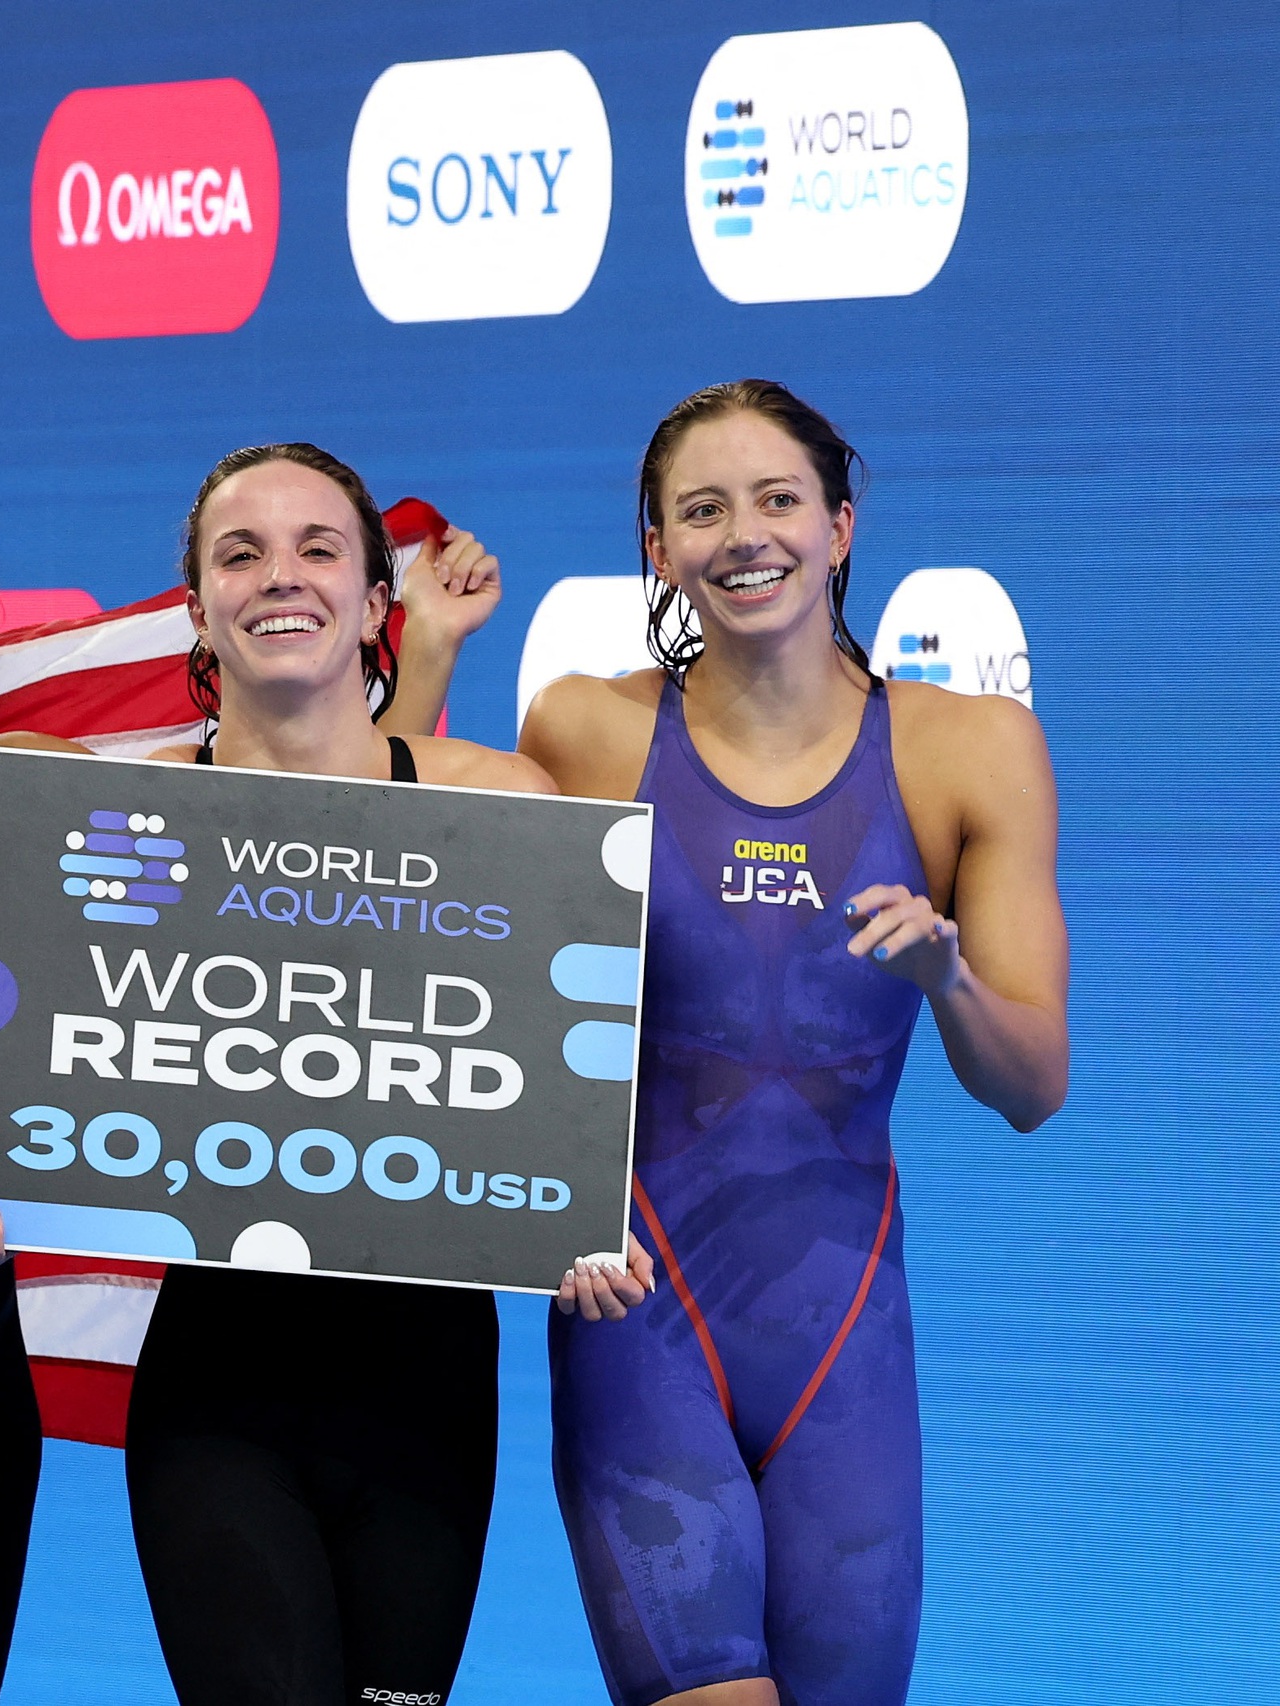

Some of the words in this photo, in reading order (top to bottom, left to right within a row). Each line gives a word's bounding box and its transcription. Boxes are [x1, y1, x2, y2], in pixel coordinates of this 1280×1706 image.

[788, 106, 913, 156] WORLD
[107, 165, 253, 243] OMEGA
[386, 148, 572, 228] SONY
[788, 160, 956, 214] AQUATICS
[221, 836, 439, 888] WORLD
[733, 838, 808, 864] arena
[215, 883, 513, 941] AQUATICS
[720, 865, 825, 910] USA
[88, 944, 493, 1037] WORLD
[49, 1012, 525, 1111] RECORD
[360, 1687, 441, 1706] speedo
